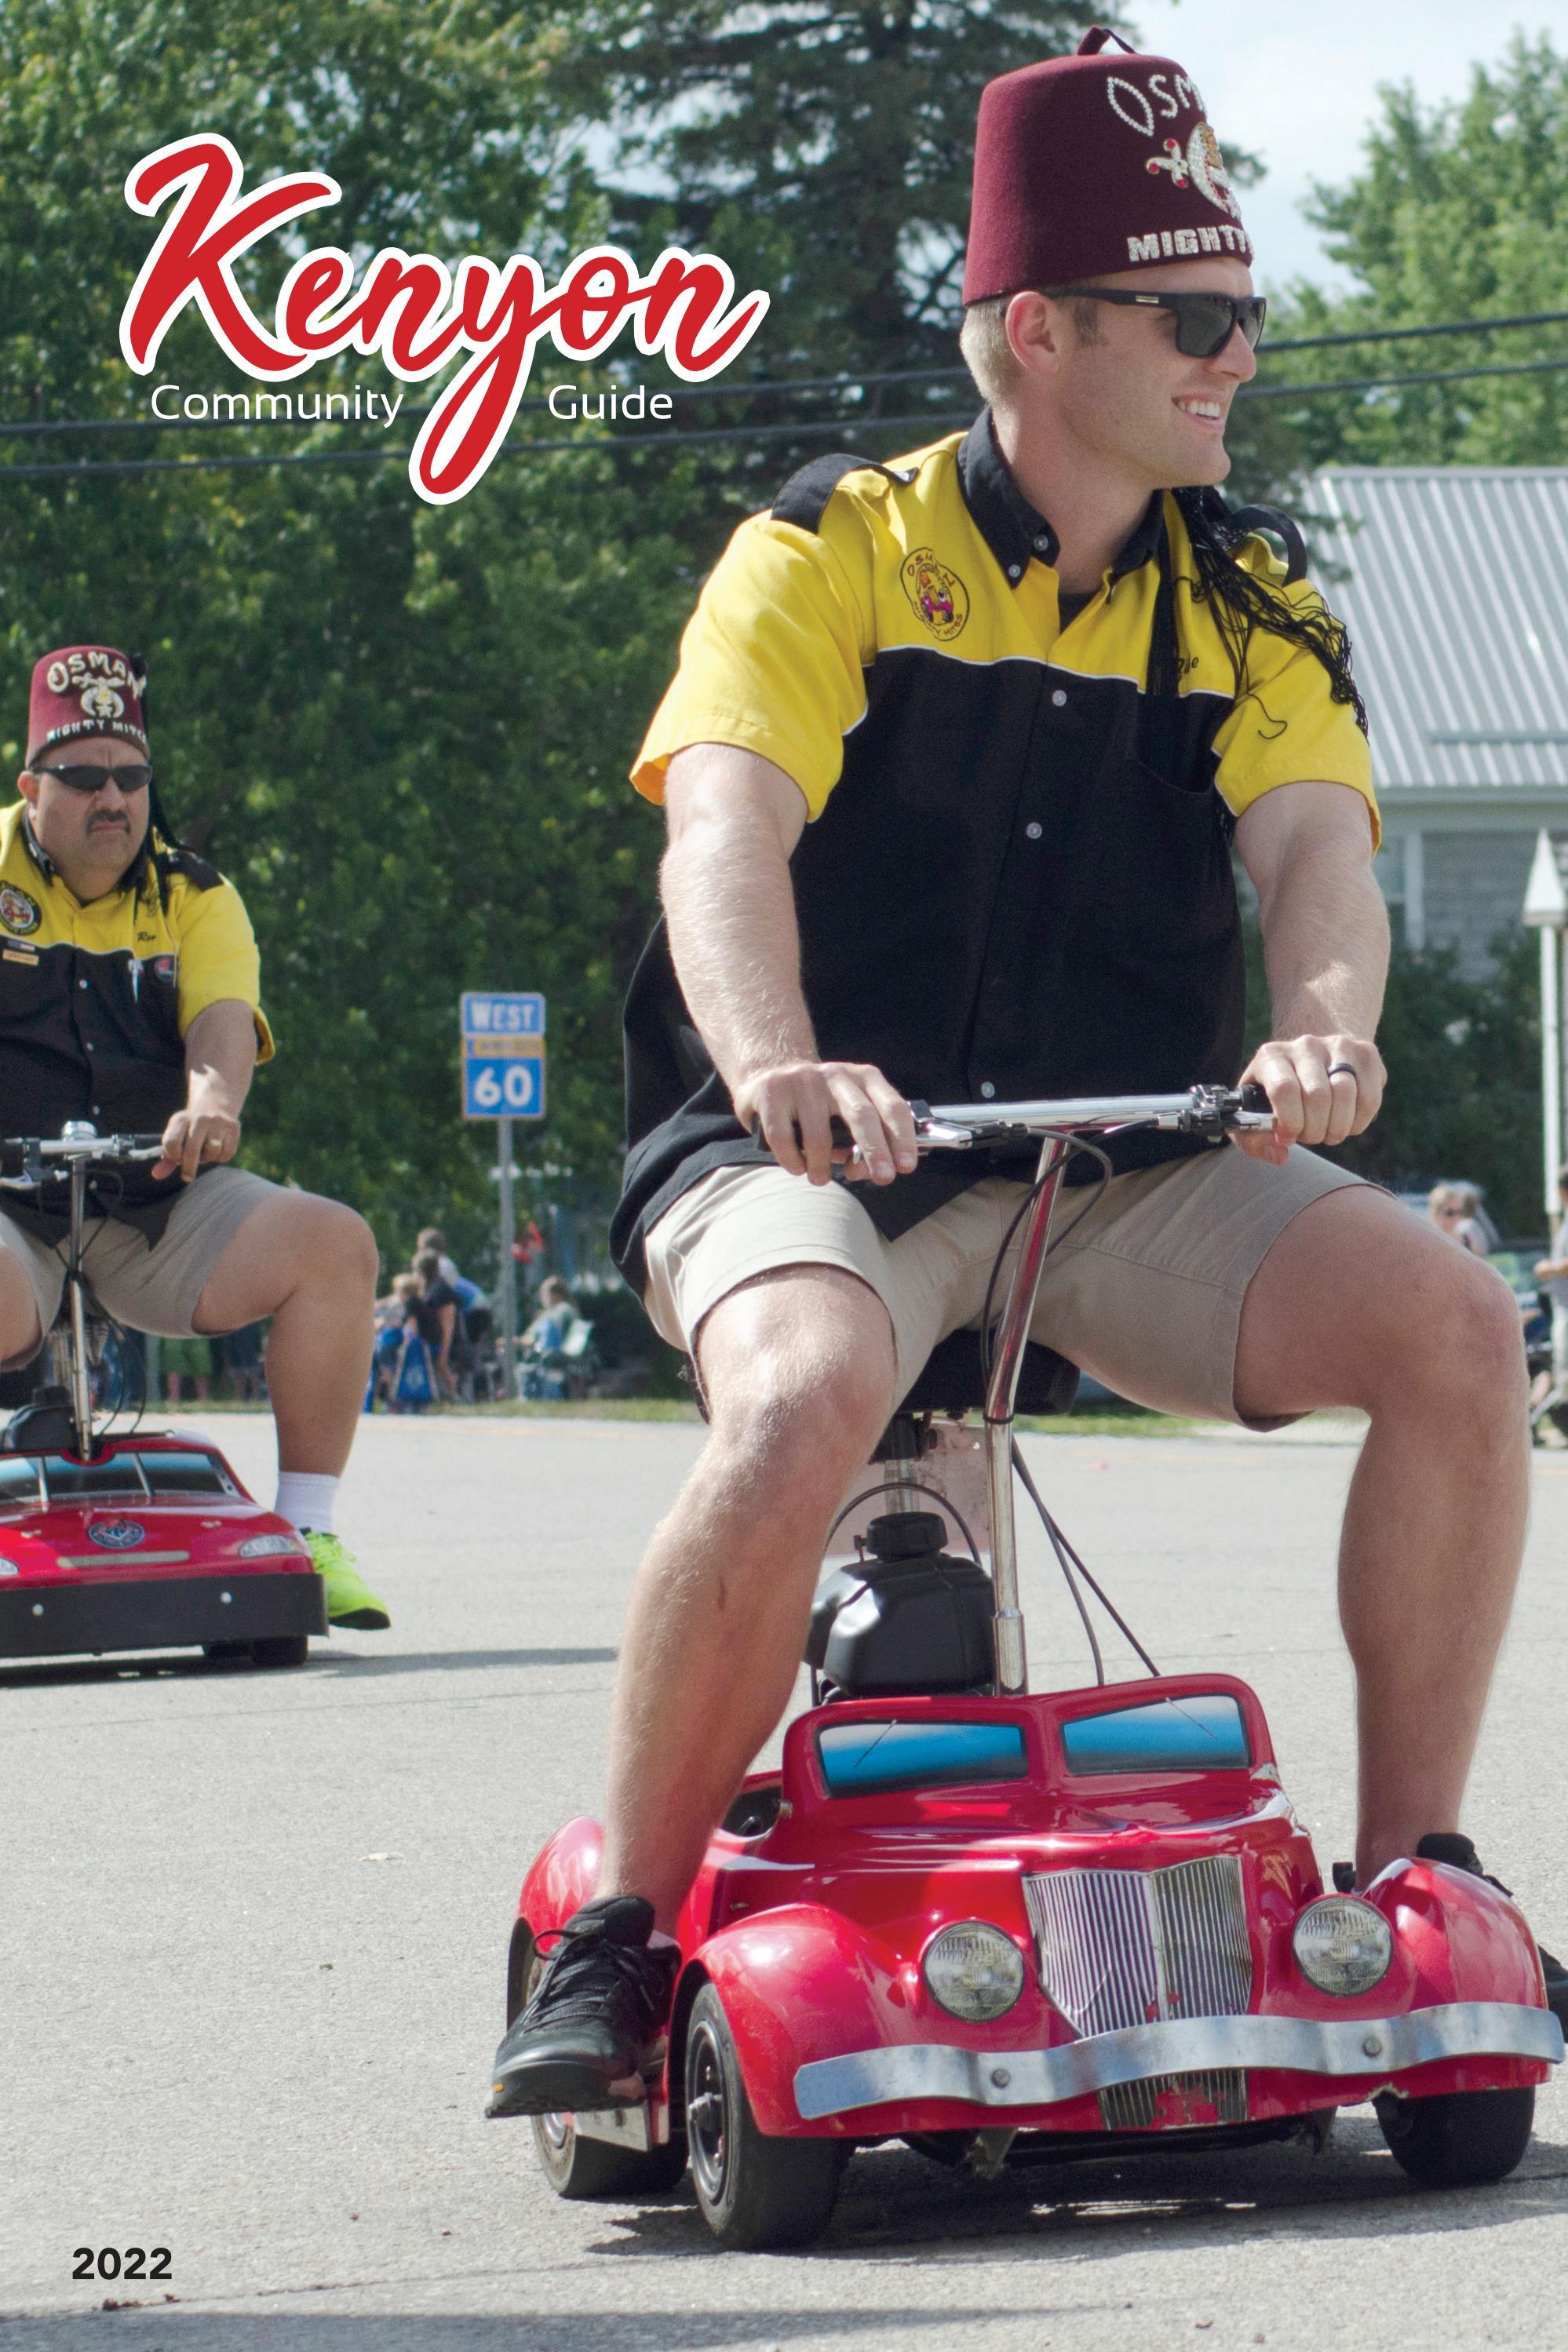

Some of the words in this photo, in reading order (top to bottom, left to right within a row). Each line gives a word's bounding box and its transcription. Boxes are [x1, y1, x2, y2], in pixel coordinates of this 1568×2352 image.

[47, 651, 147, 700] OSMAN
[47, 720, 104, 742] MIGHTY
[472, 1001, 534, 1030] WEST
[474, 1065, 533, 1107] 60
